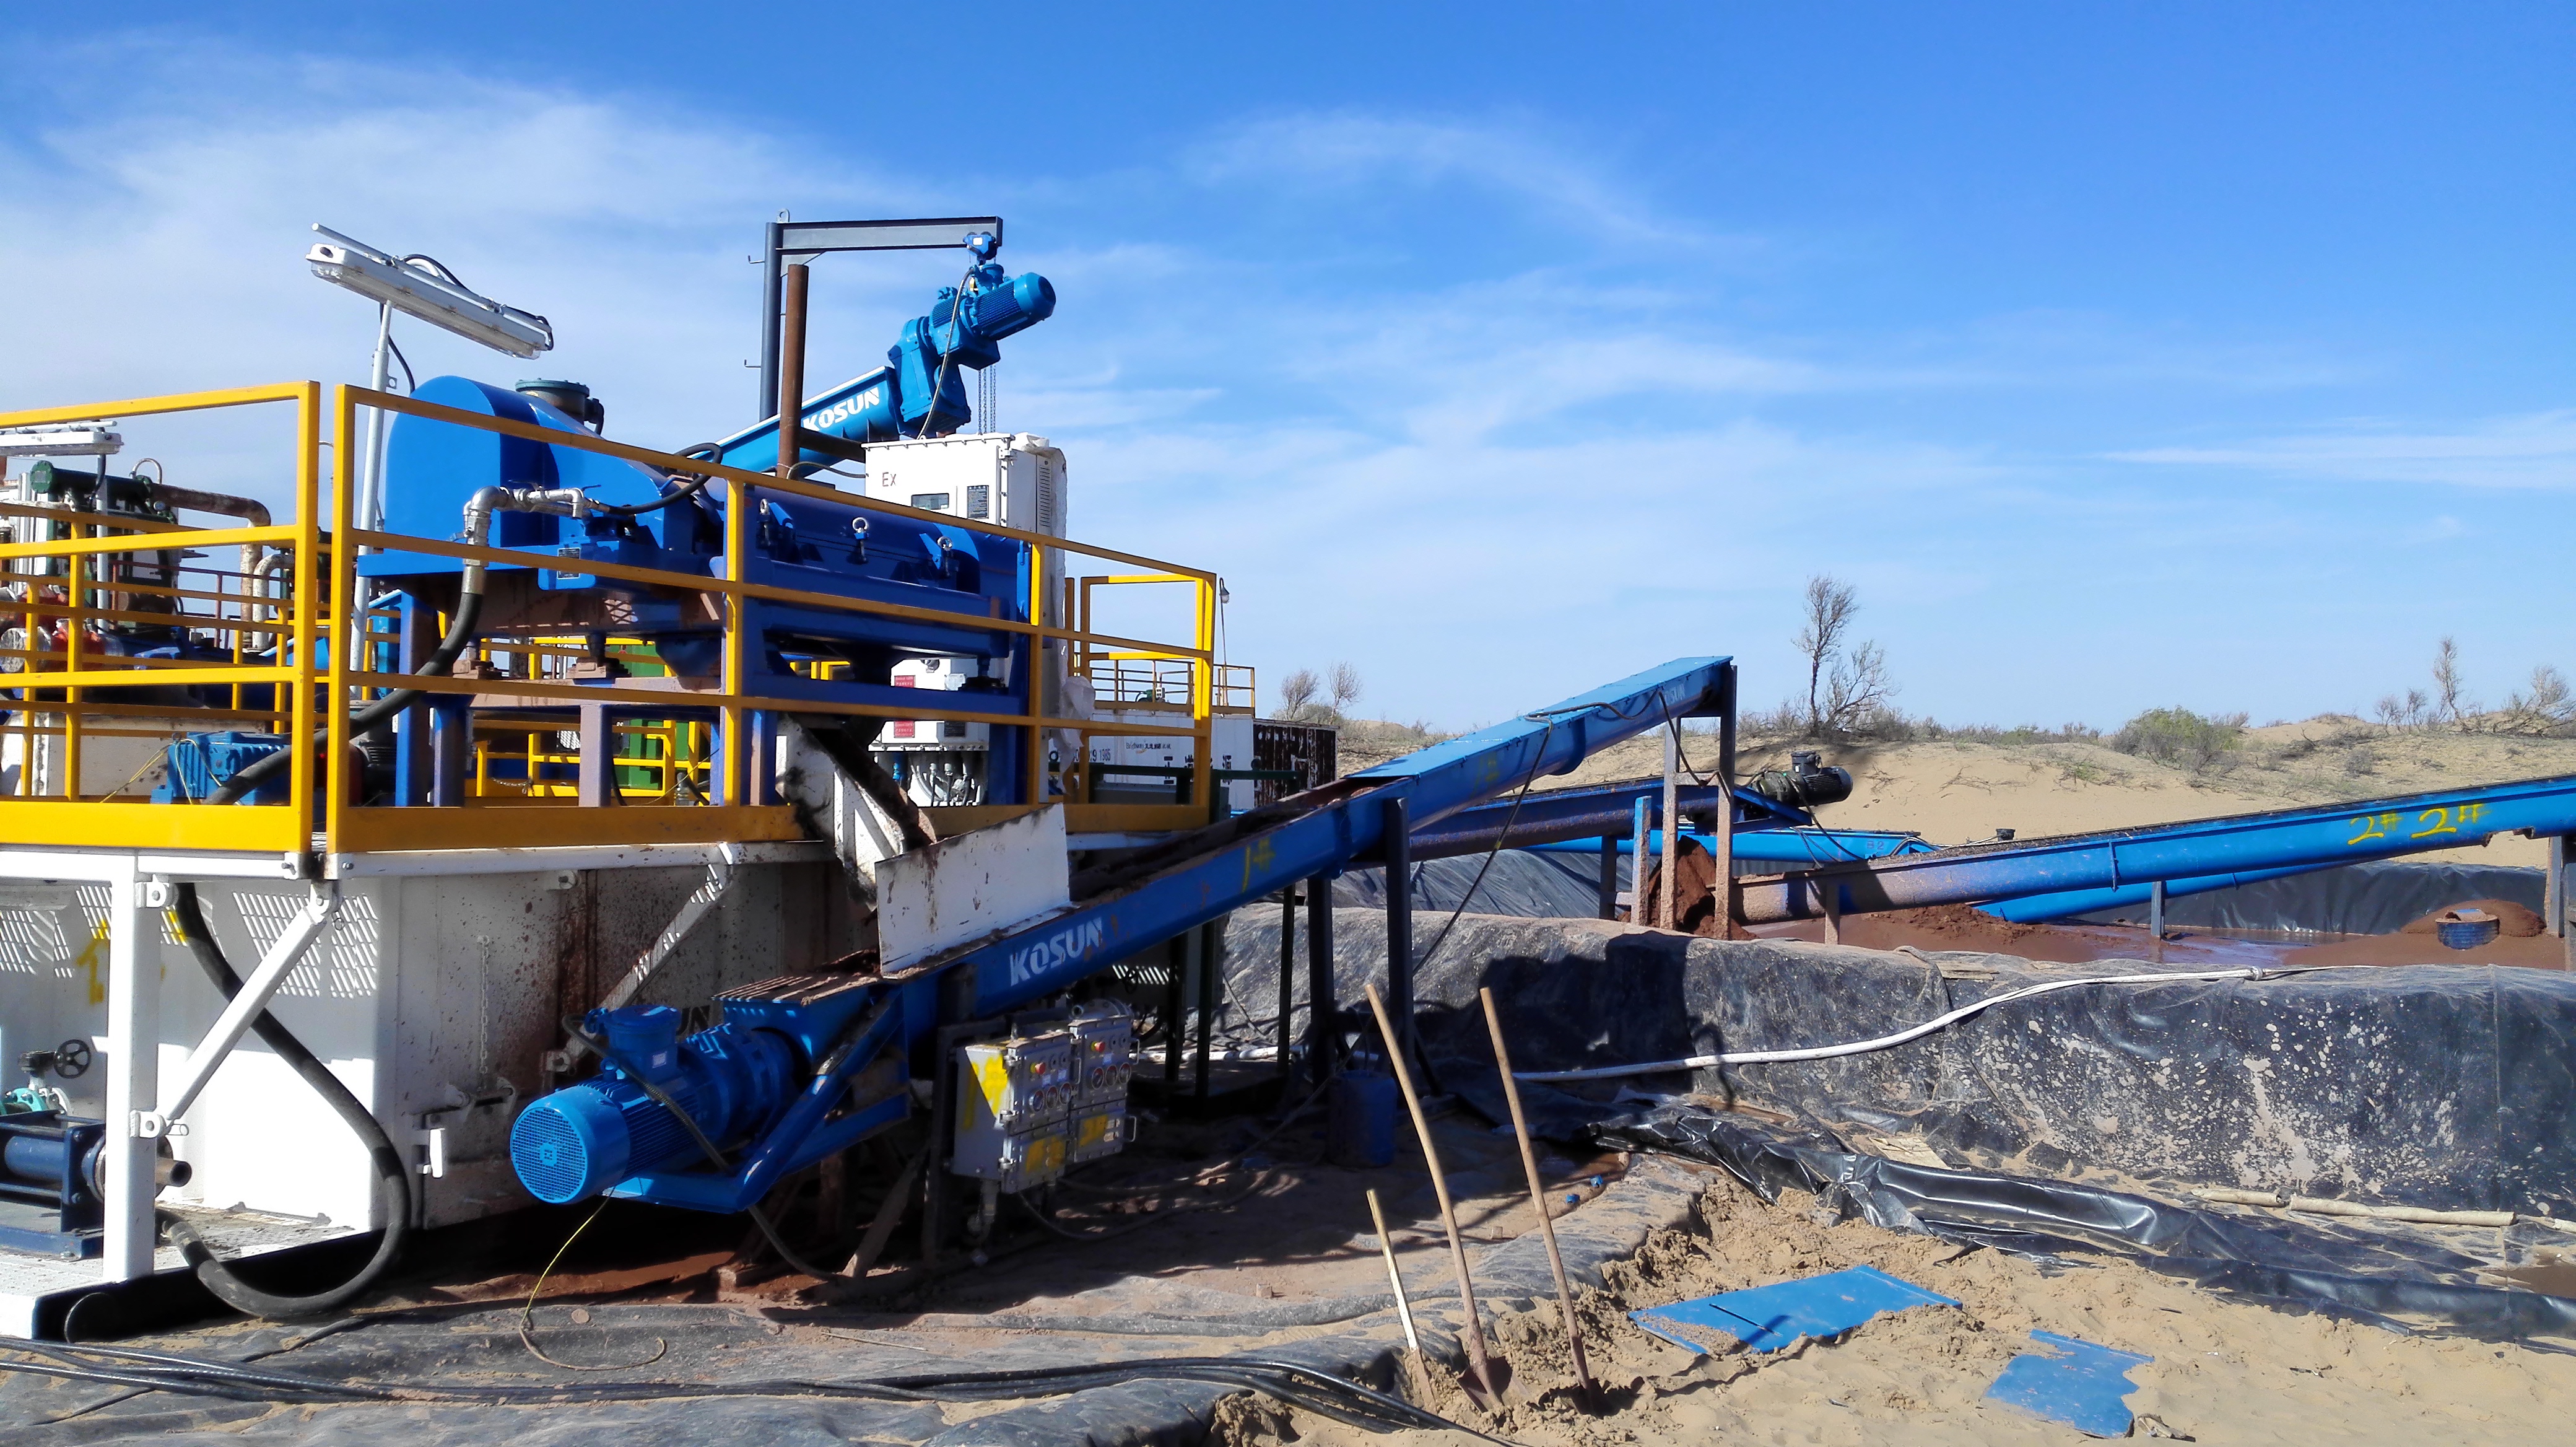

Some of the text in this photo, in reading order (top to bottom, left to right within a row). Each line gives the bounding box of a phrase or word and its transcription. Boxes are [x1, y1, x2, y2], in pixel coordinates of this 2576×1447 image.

[803, 387, 879, 431] KOSUN
[2411, 803, 2492, 838] 2#
[1009, 917, 1102, 987] KOSUN
